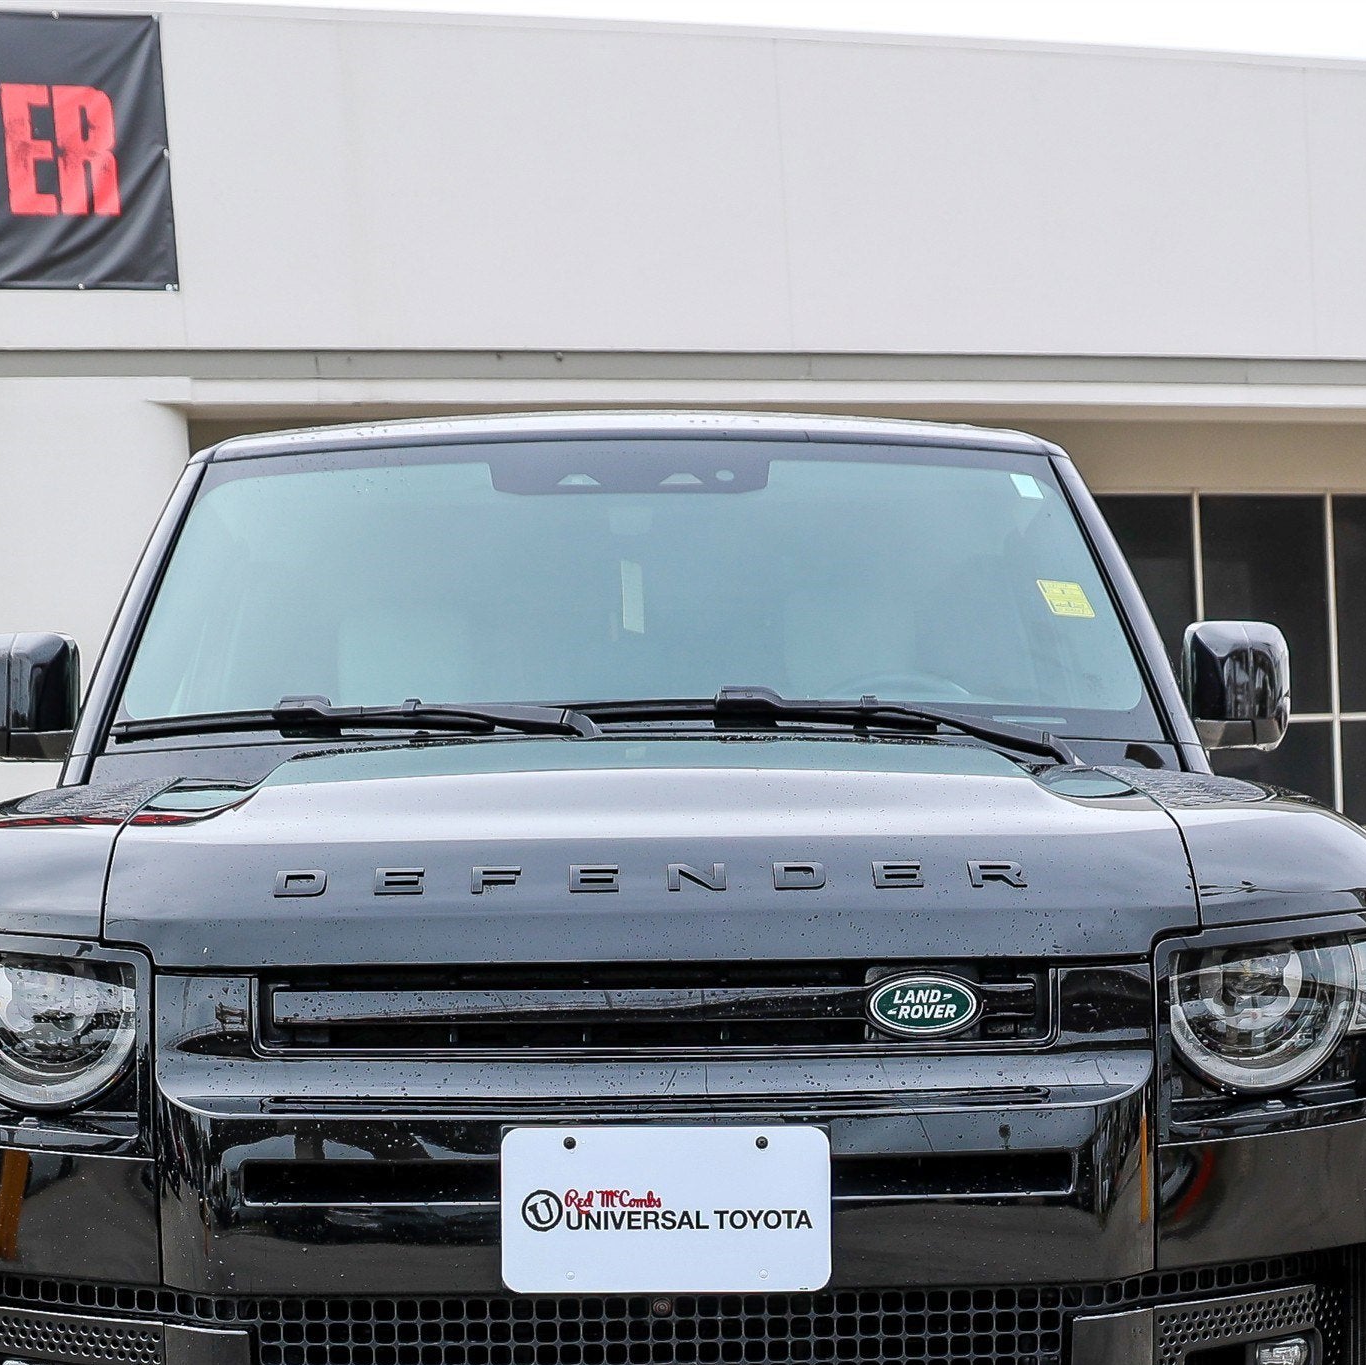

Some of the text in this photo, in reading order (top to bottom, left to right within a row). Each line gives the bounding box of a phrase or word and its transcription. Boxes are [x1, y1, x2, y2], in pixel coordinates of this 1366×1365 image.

[272, 859, 1028, 898] DEFENDER
[893, 989, 942, 1004] LAND
[897, 1003, 957, 1020] ROVER
[564, 1188, 662, 1214] Red McCombs
[566, 1209, 709, 1231] UNIVERSAL
[713, 1209, 814, 1231] TOYOTA
